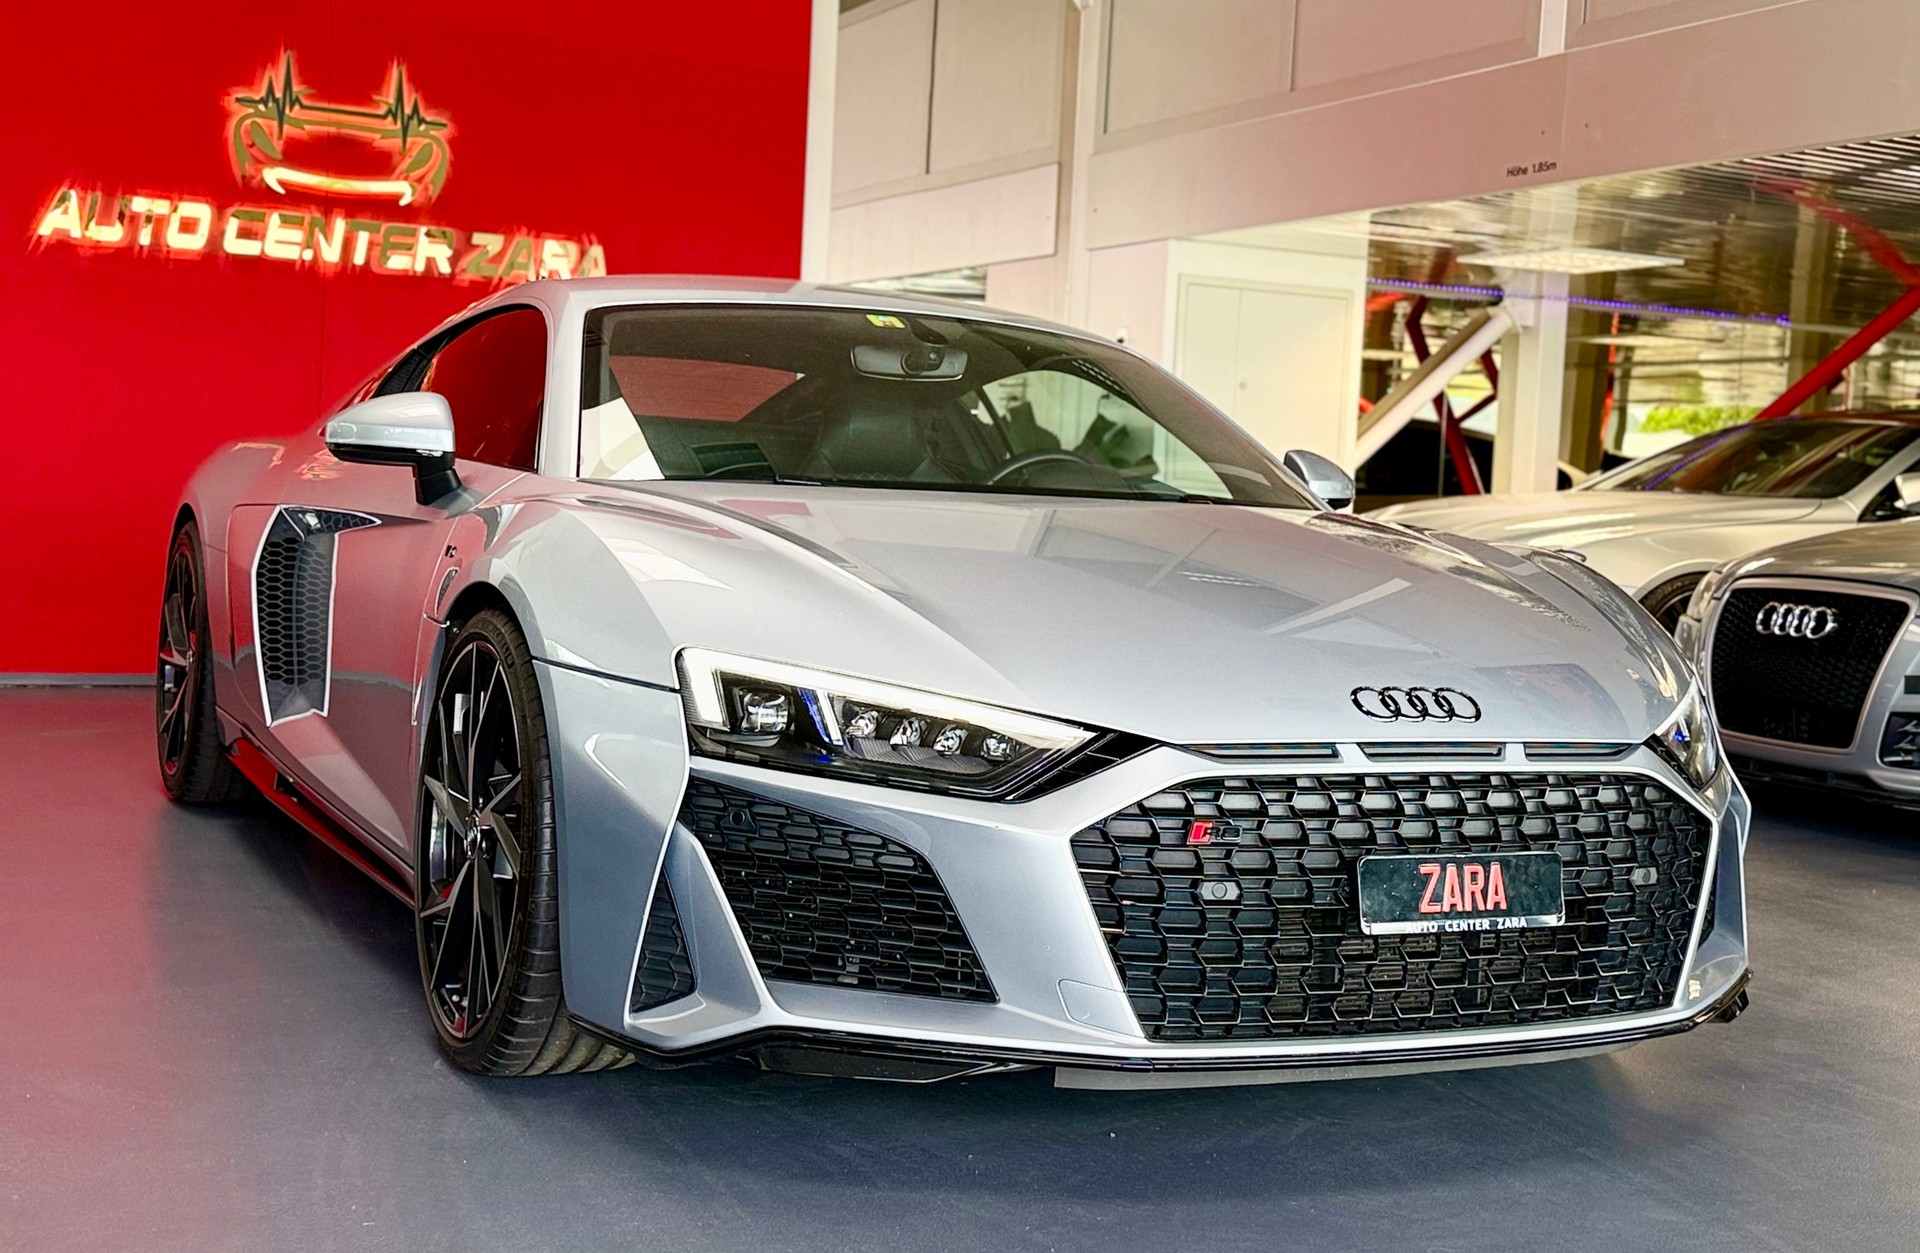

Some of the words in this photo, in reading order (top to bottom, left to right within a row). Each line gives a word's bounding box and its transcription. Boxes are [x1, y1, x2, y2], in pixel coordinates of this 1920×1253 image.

[1506, 165, 1529, 178] Höhe
[1532, 160, 1557, 173] 1.85m
[37, 188, 212, 250] AUTO
[222, 206, 453, 275] CENTER
[465, 231, 608, 282] ZARA
[1418, 861, 1508, 914] ZARA
[1405, 921, 1439, 935] AUTO
[1444, 919, 1491, 933] CENTER
[1496, 916, 1528, 930] ZARA
